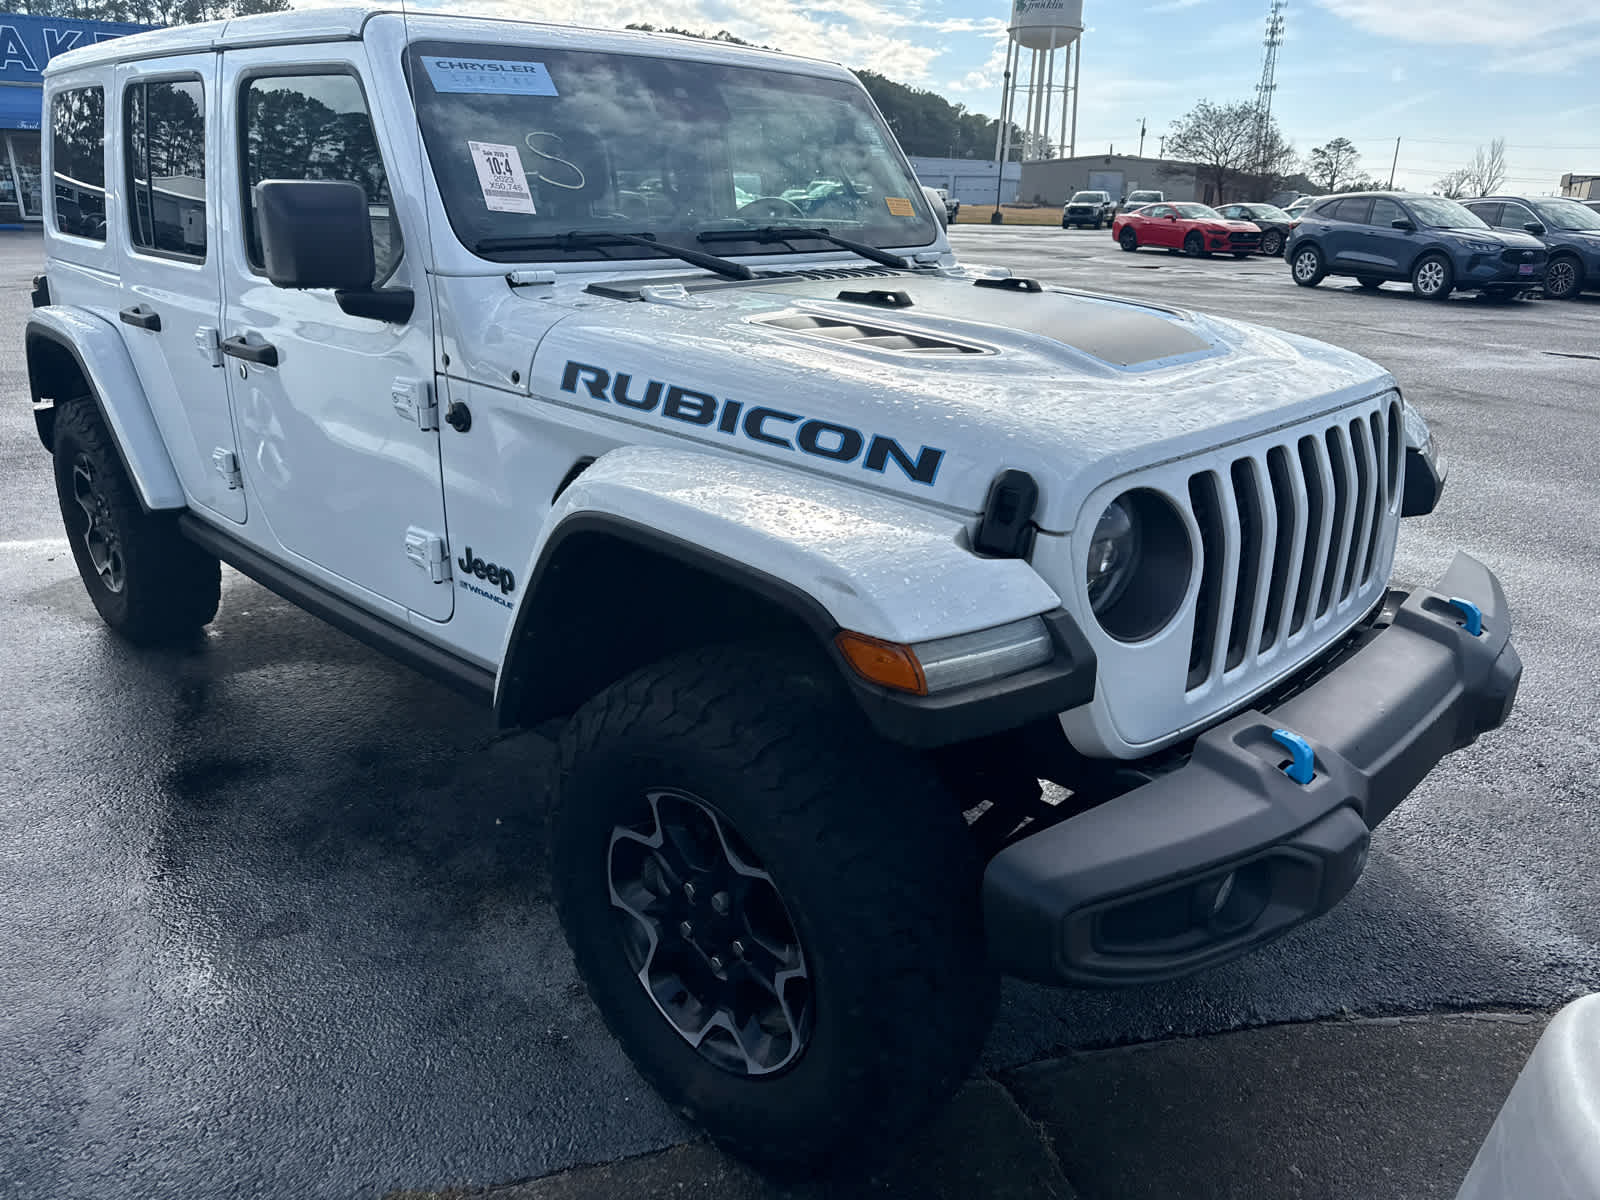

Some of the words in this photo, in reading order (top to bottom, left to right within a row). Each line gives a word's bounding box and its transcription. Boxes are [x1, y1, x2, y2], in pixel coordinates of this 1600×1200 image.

[0, 25, 126, 71] AK
[435, 61, 537, 73] CHRYSLER
[486, 157, 513, 176] 10:4
[493, 175, 515, 184] 2023
[559, 359, 947, 487] RUBICON
[457, 545, 516, 596] Jeep
